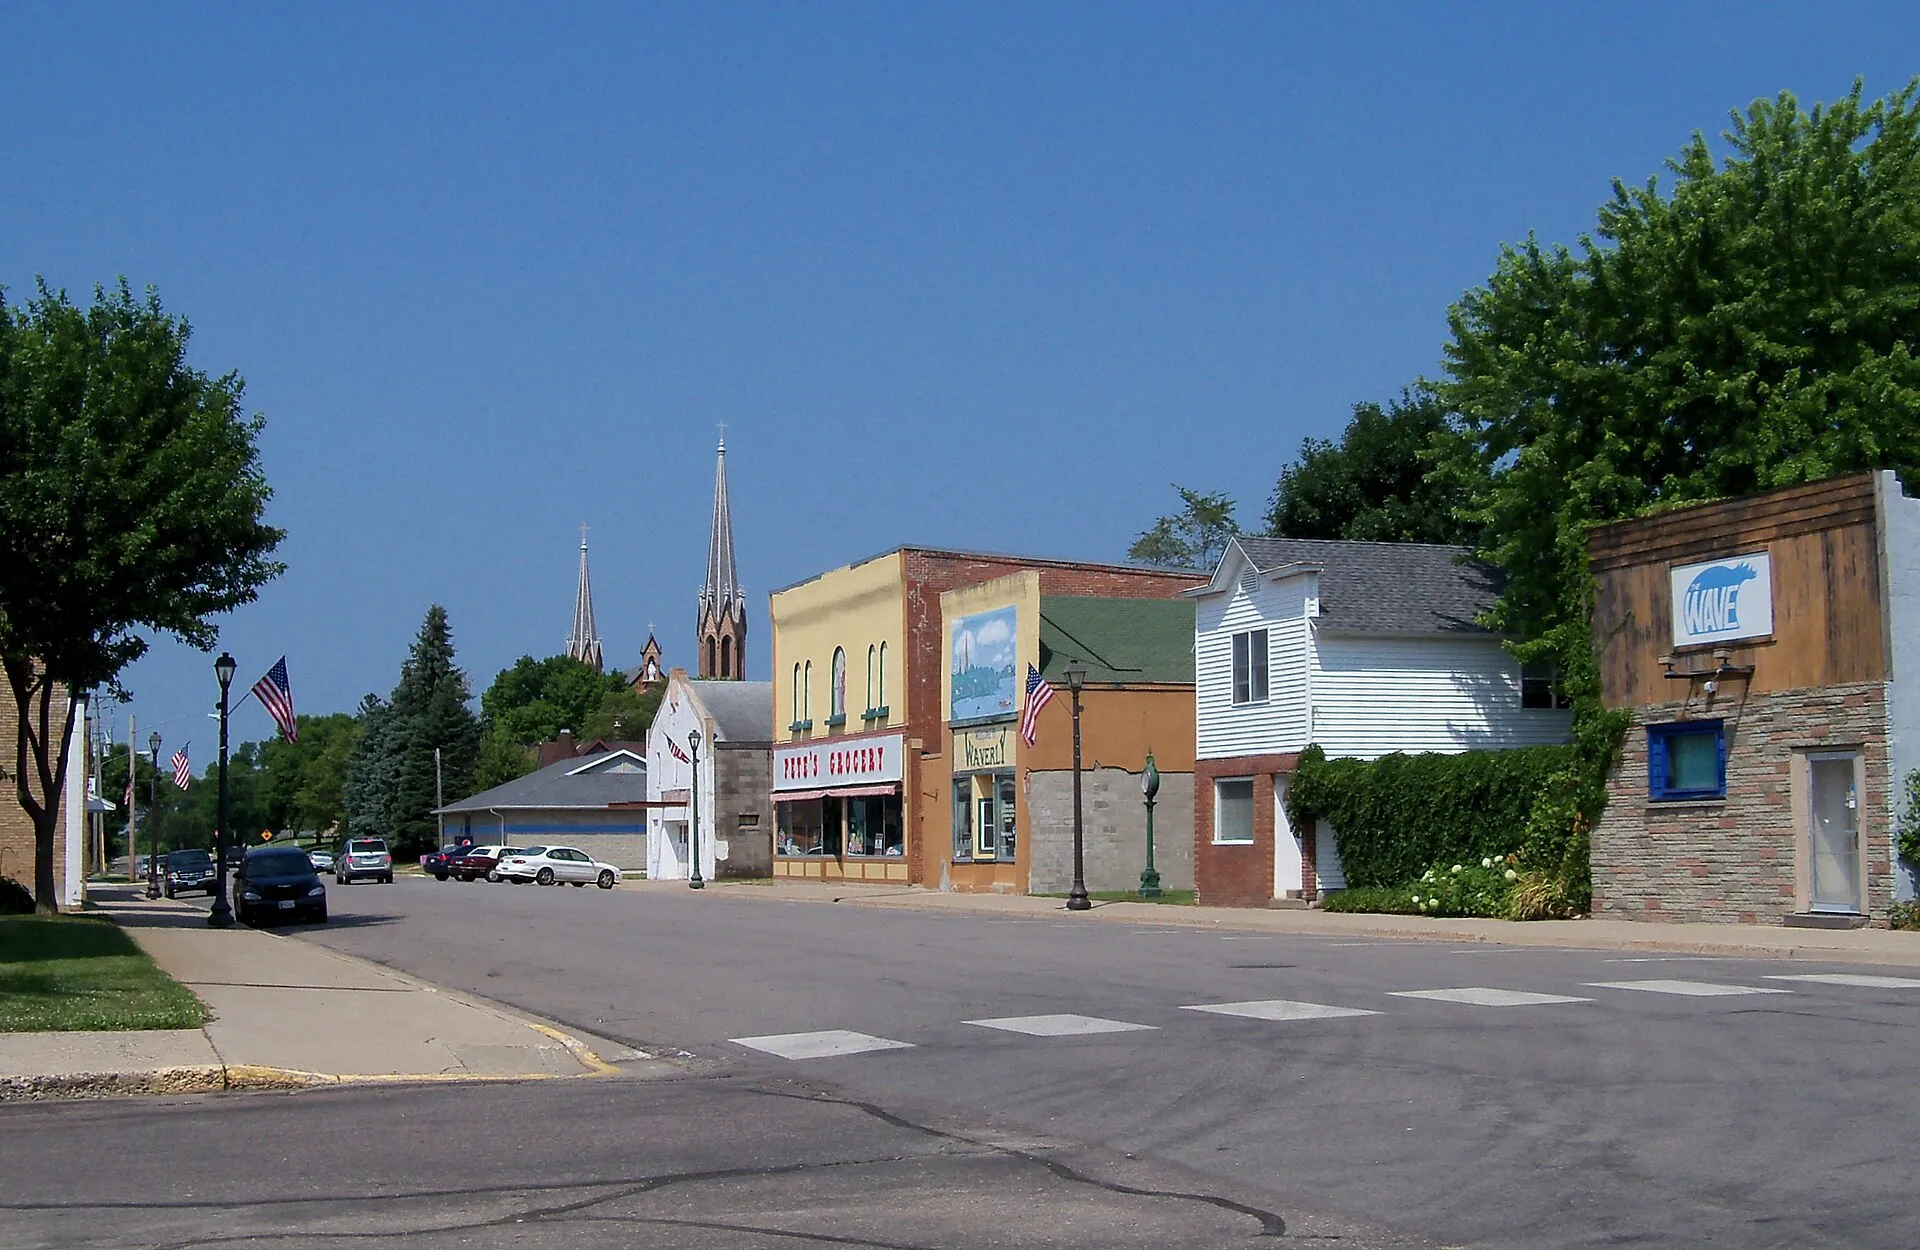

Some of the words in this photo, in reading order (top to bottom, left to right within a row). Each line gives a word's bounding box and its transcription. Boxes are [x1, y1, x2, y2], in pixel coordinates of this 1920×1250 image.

[1684, 586, 1740, 634] WAVE
[784, 751, 818, 780] PETE'S
[829, 747, 884, 776] GROCERY
[964, 726, 1006, 768] WAVERLY
